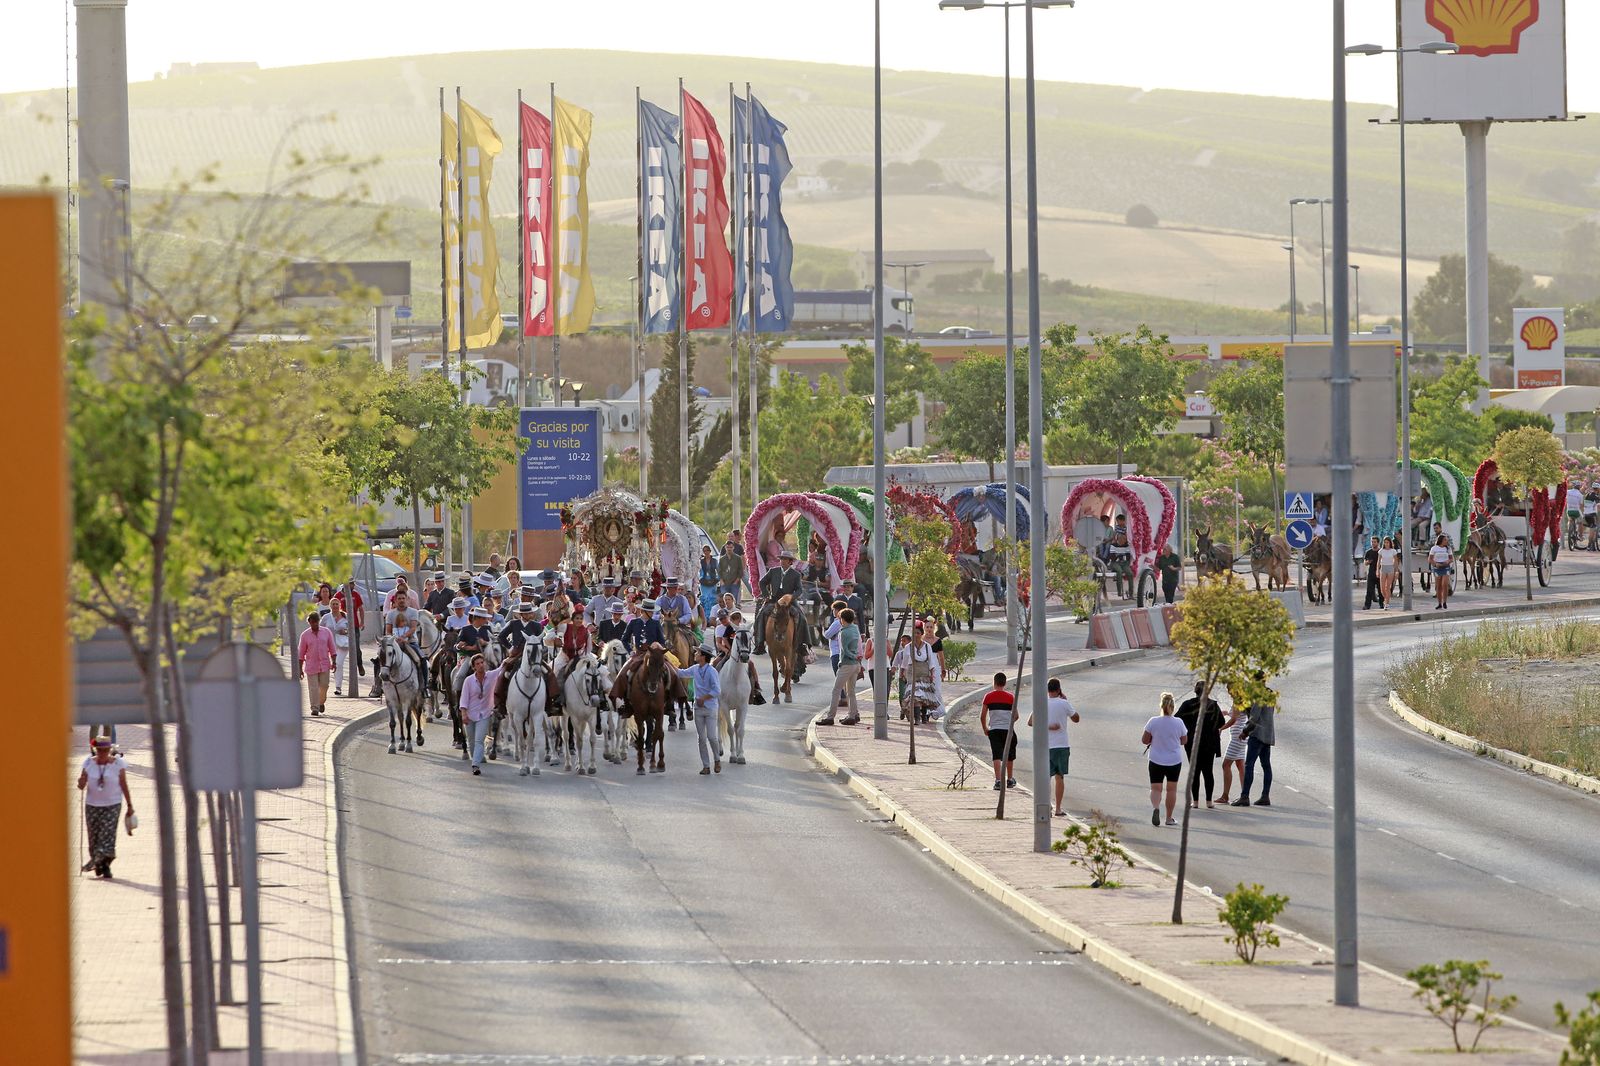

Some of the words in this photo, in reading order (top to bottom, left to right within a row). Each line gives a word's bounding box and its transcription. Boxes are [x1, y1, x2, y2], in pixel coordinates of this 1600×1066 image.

[466, 146, 484, 320] IKEA
[527, 148, 547, 320] IKEA
[559, 144, 581, 318] IKEA
[648, 146, 670, 318] IKEA
[691, 138, 710, 314] IKEA
[758, 143, 776, 317] IKEA
[528, 421, 568, 433] Gracias
[571, 422, 589, 435] por
[536, 439, 549, 449] su
[552, 437, 581, 449] visita
[568, 452, 591, 461] 10-22
[1189, 402, 1206, 411] Car
